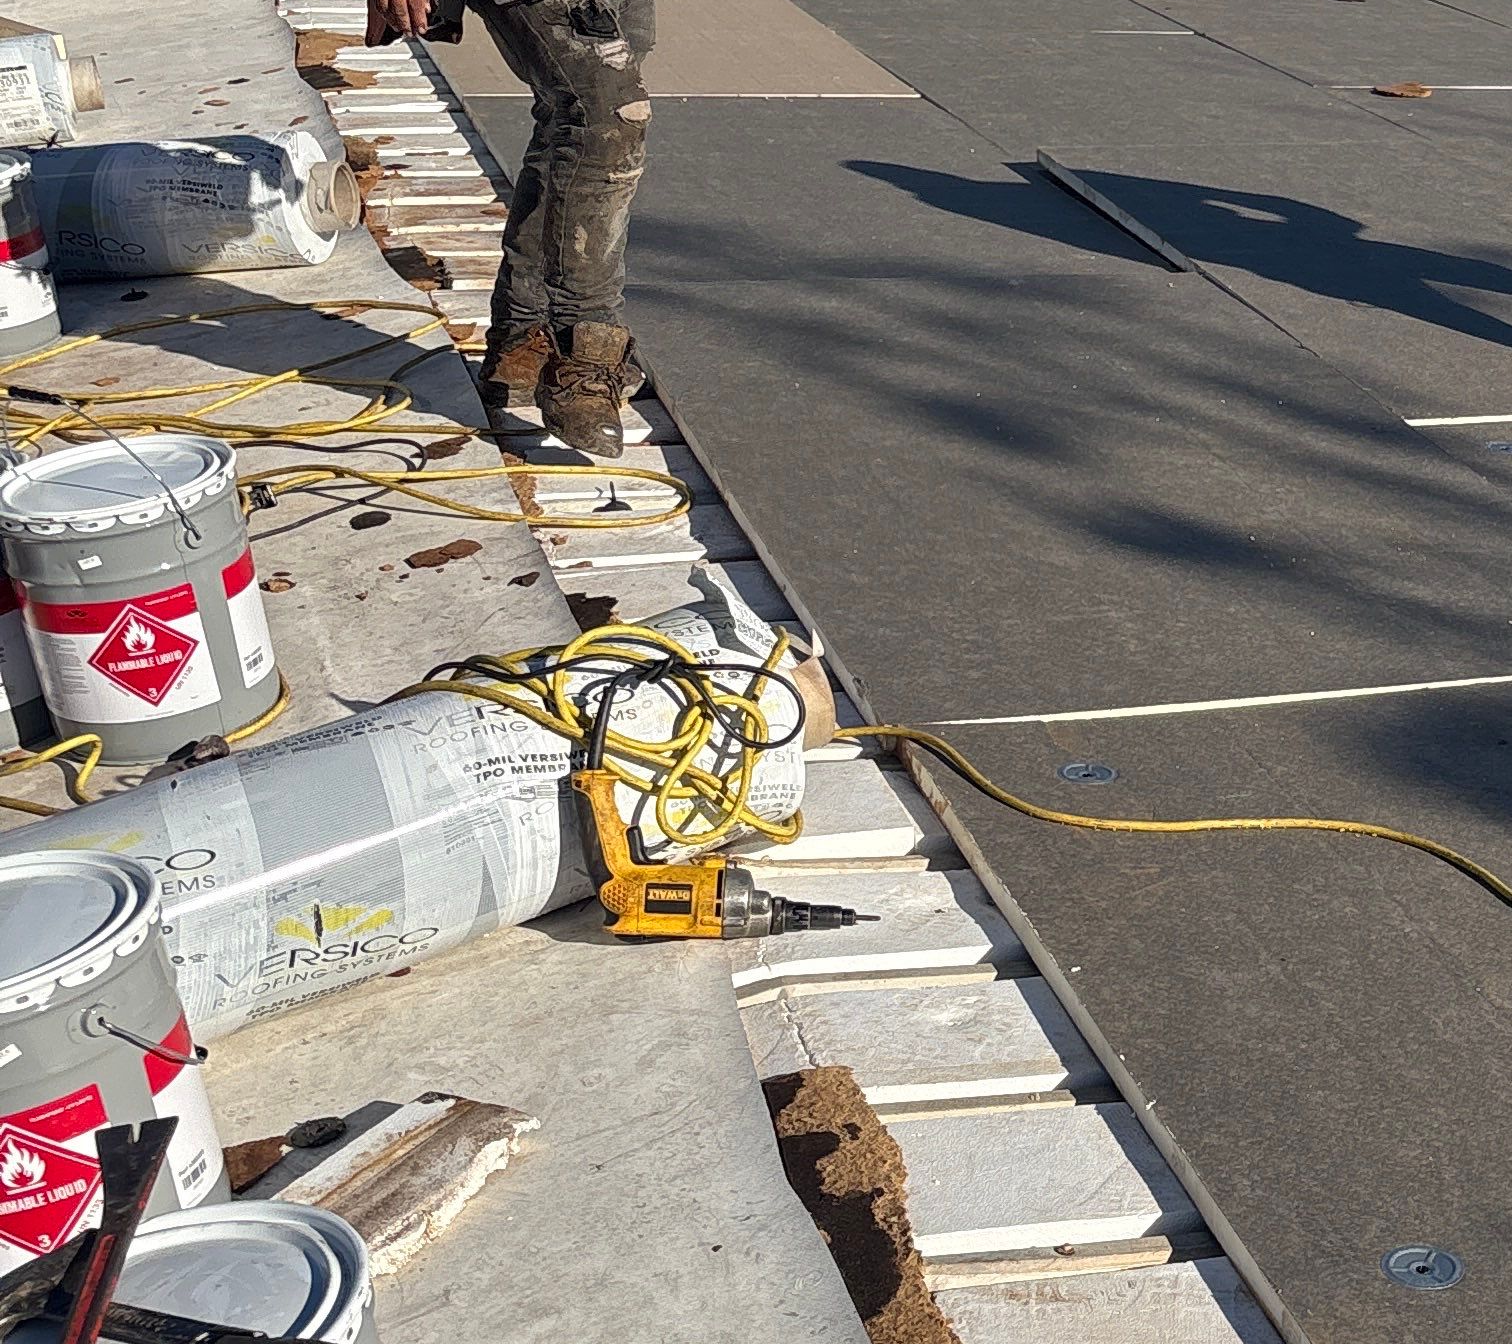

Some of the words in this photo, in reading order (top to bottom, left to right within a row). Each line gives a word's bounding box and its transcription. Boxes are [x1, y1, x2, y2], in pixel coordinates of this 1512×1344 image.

[59, 230, 145, 255] RSICO
[107, 656, 155, 672] FLAMMABLE
[155, 649, 183, 666] LIQUID
[147, 687, 157, 697] 3
[414, 720, 528, 754] ROOFING
[474, 768, 505, 784] TPO
[214, 927, 439, 988] VERSICO
[212, 969, 327, 1010] ROOFING
[336, 942, 431, 974] SYSTEMS
[46, 1178, 87, 1203] LIQUID
[37, 1234, 51, 1248] 3
